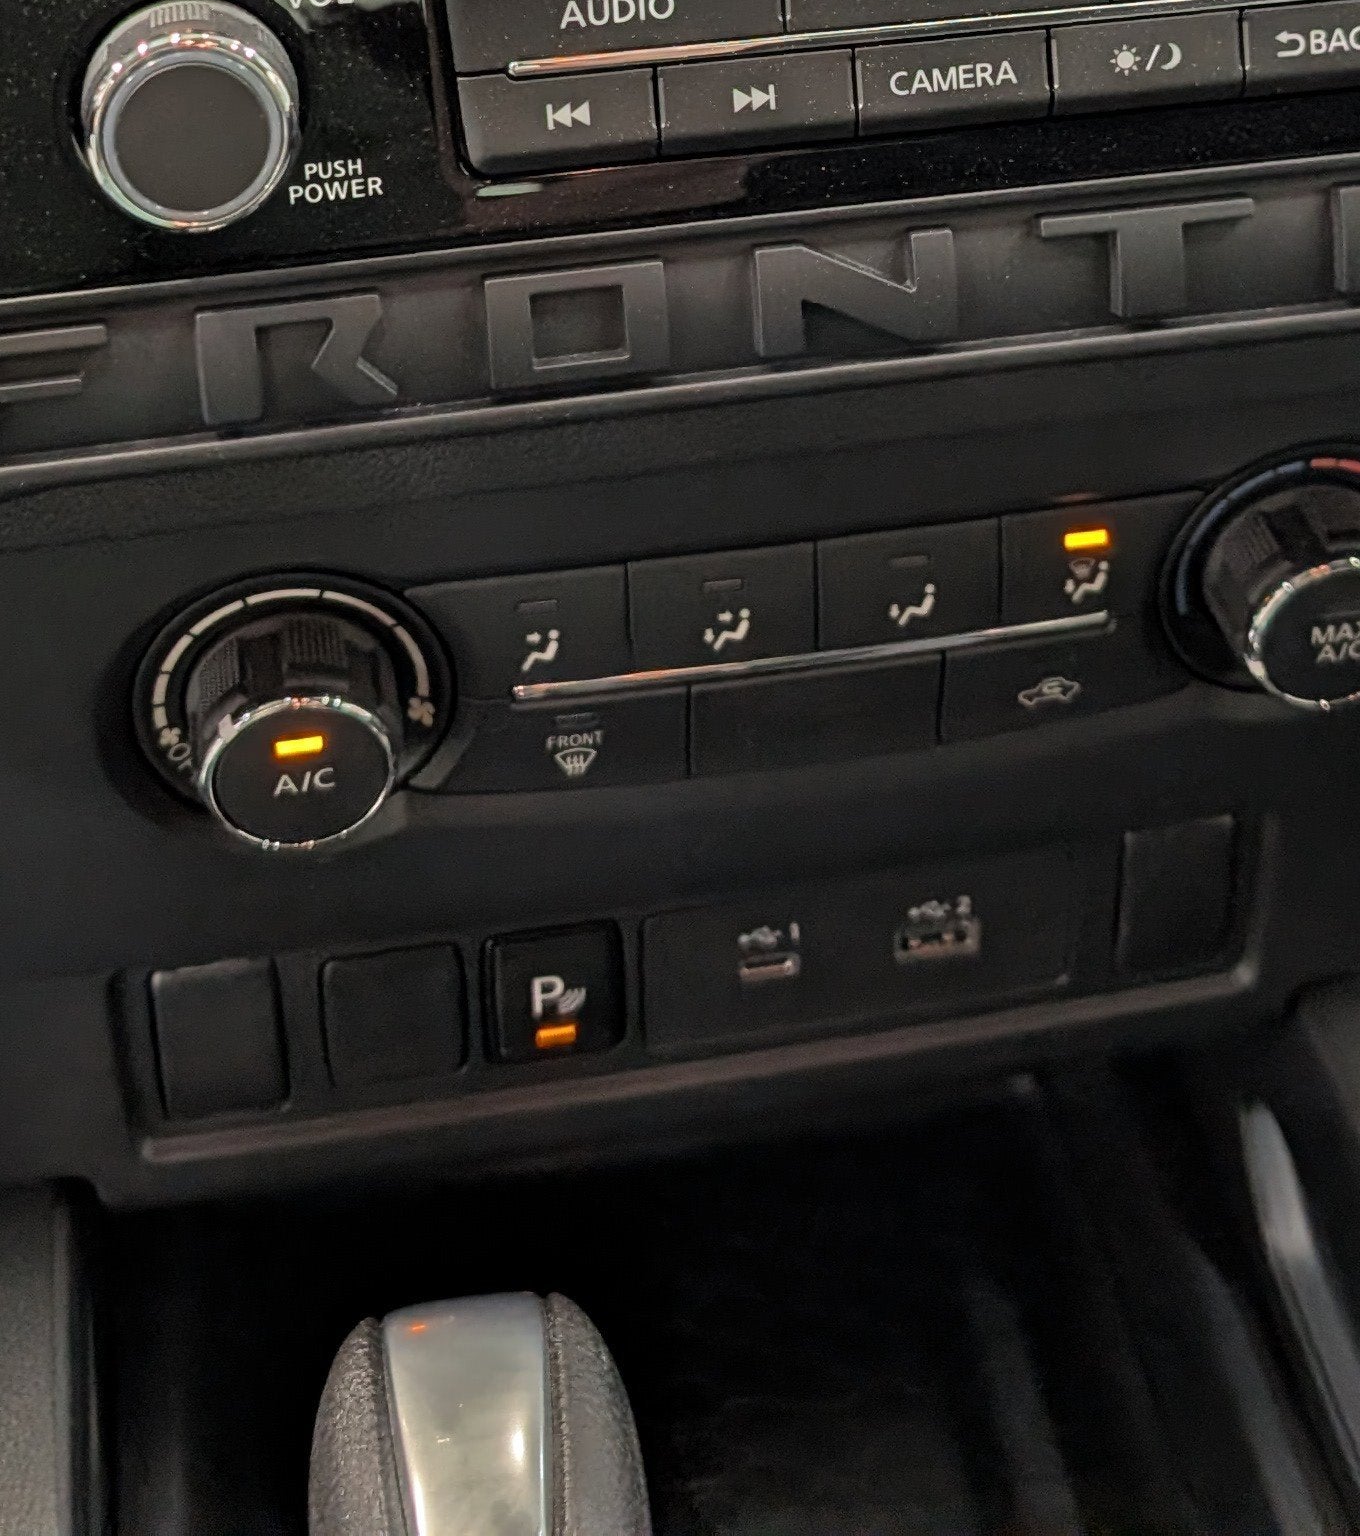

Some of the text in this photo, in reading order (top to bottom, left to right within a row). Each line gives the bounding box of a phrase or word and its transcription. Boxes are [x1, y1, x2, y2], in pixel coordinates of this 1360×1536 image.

[890, 60, 1017, 96] CAMERA
[304, 158, 363, 182] PUSH
[289, 176, 383, 205] POWER
[546, 729, 603, 752] FRONT
[273, 767, 335, 798] A/C
